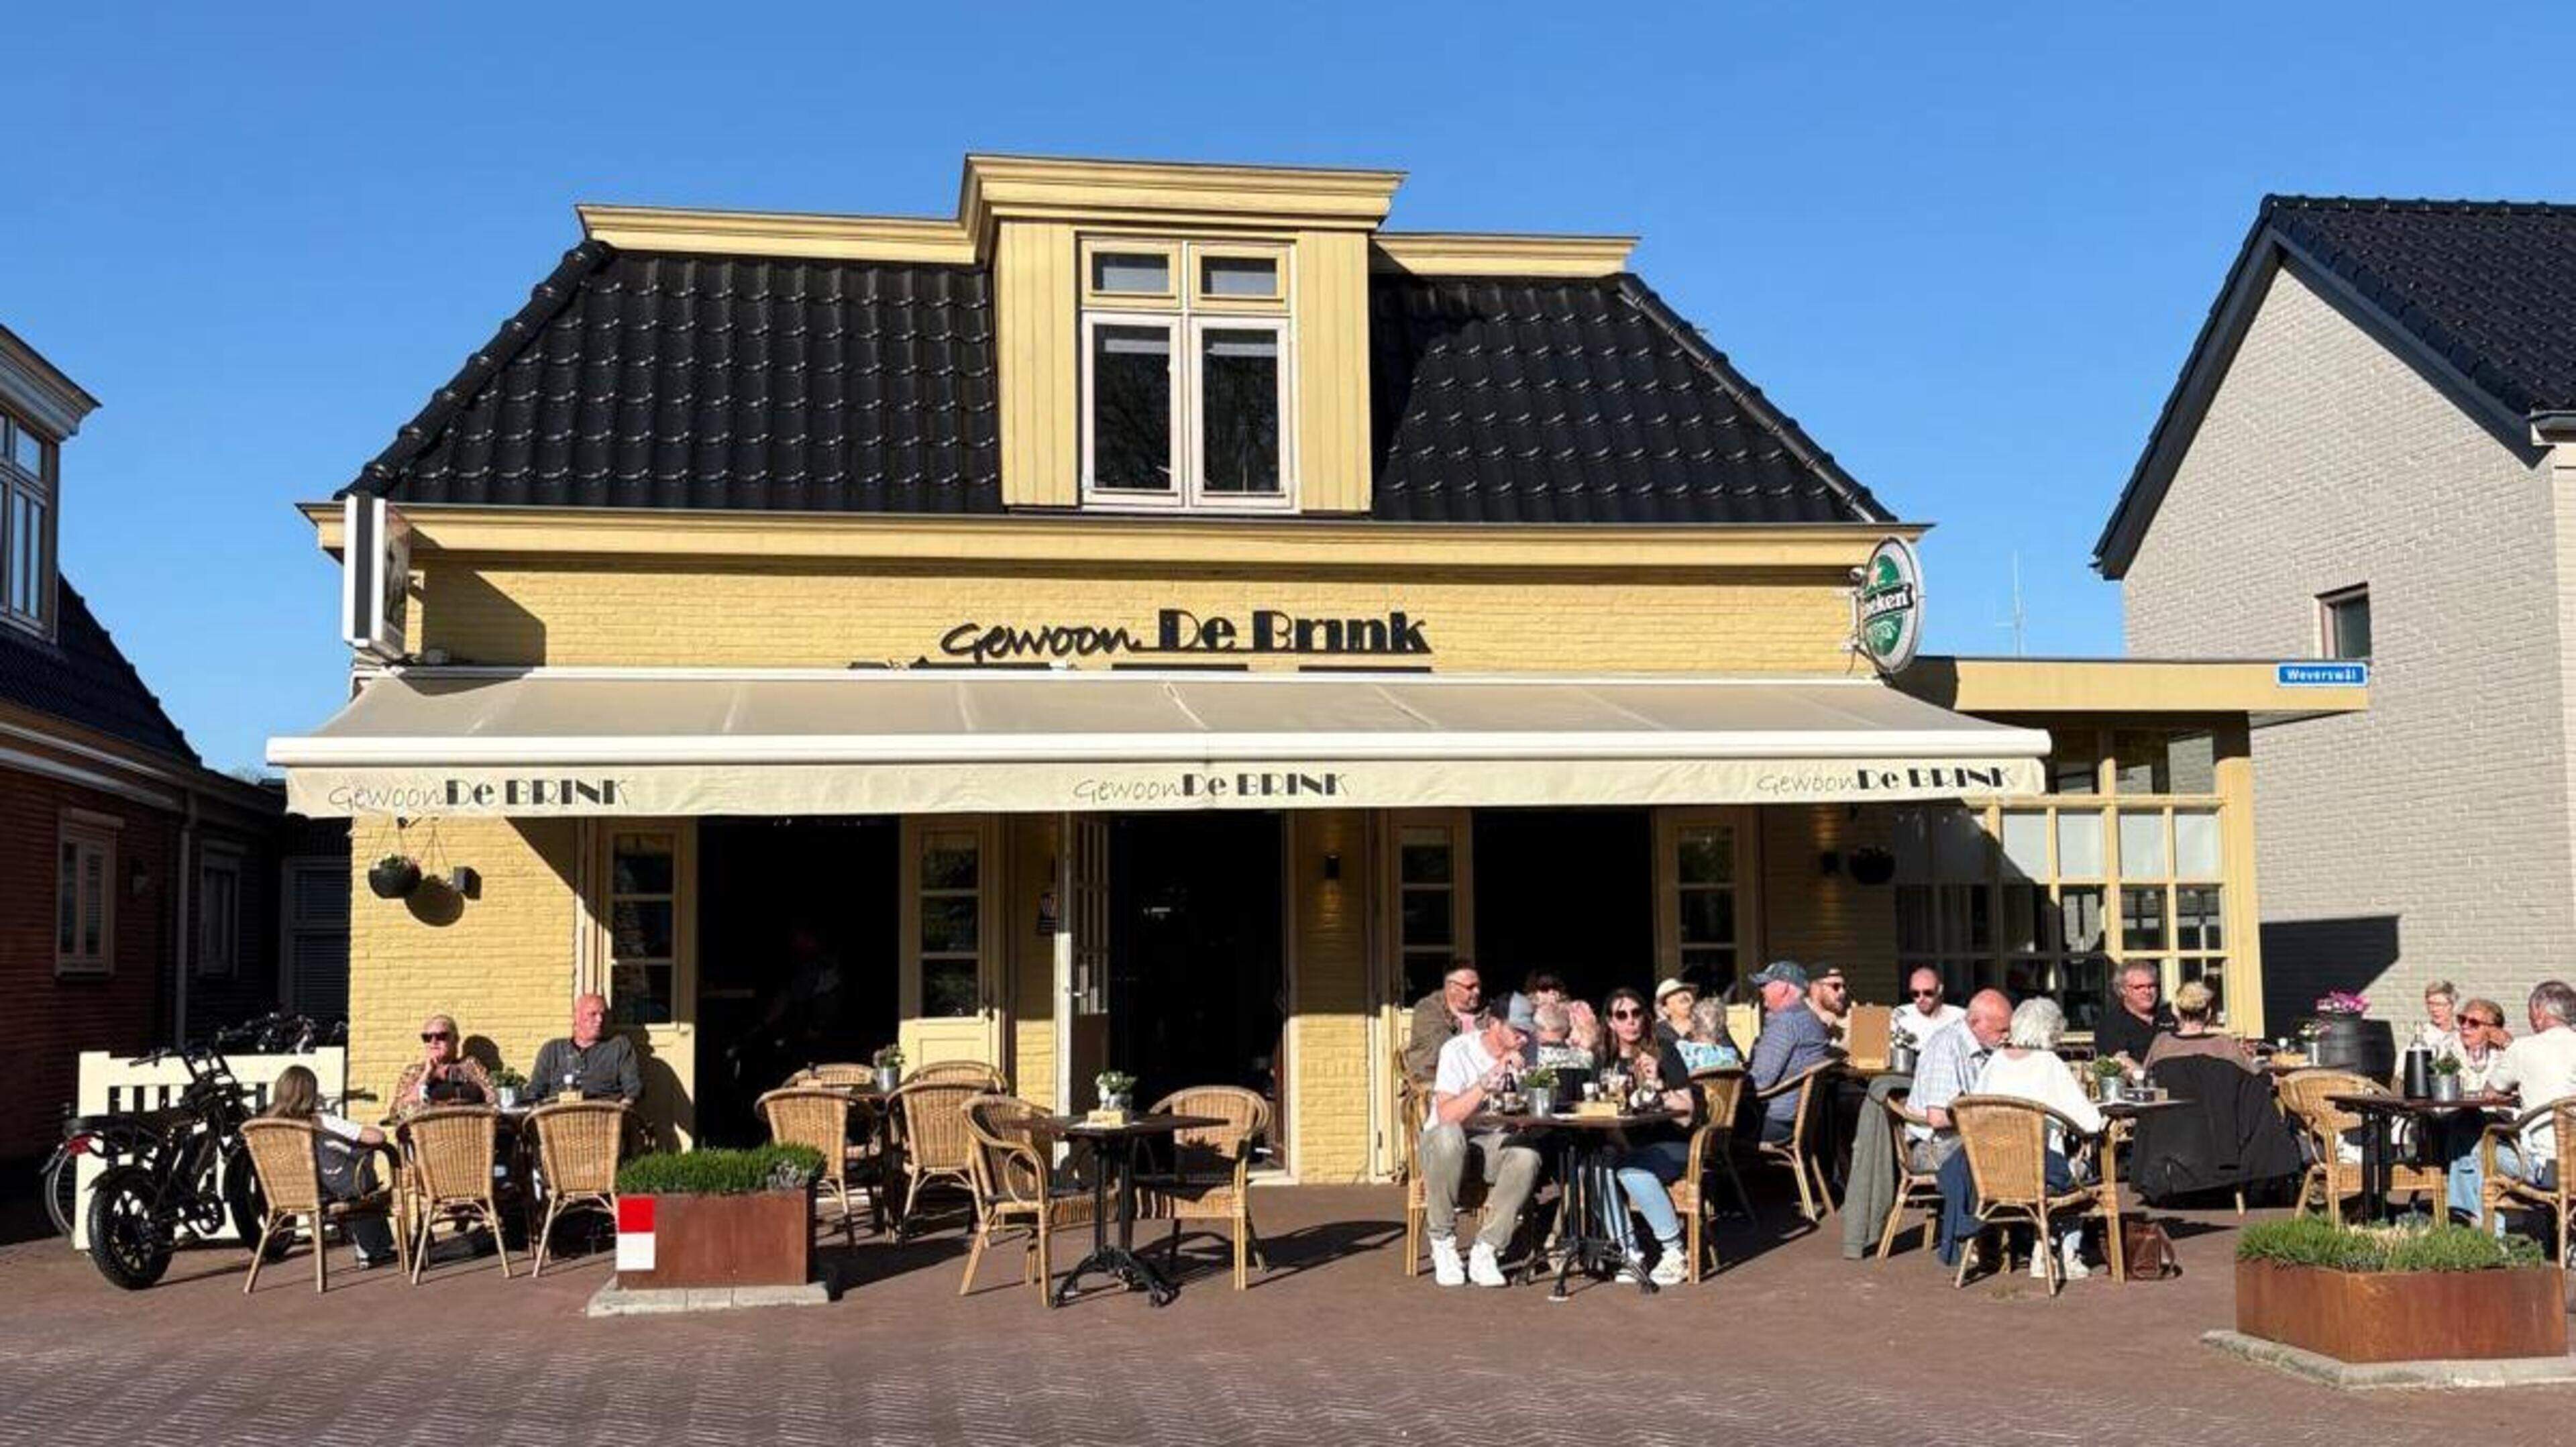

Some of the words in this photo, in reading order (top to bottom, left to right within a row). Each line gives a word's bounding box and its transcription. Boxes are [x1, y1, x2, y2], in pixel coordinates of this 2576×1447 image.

[941, 622, 1142, 663] Gewoon
[1159, 608, 1237, 652] De
[1253, 610, 1432, 654] Brink
[1236, 773, 1350, 796] BRINK
[1907, 766, 2013, 788] BRINK
[505, 779, 629, 806] BRINK
